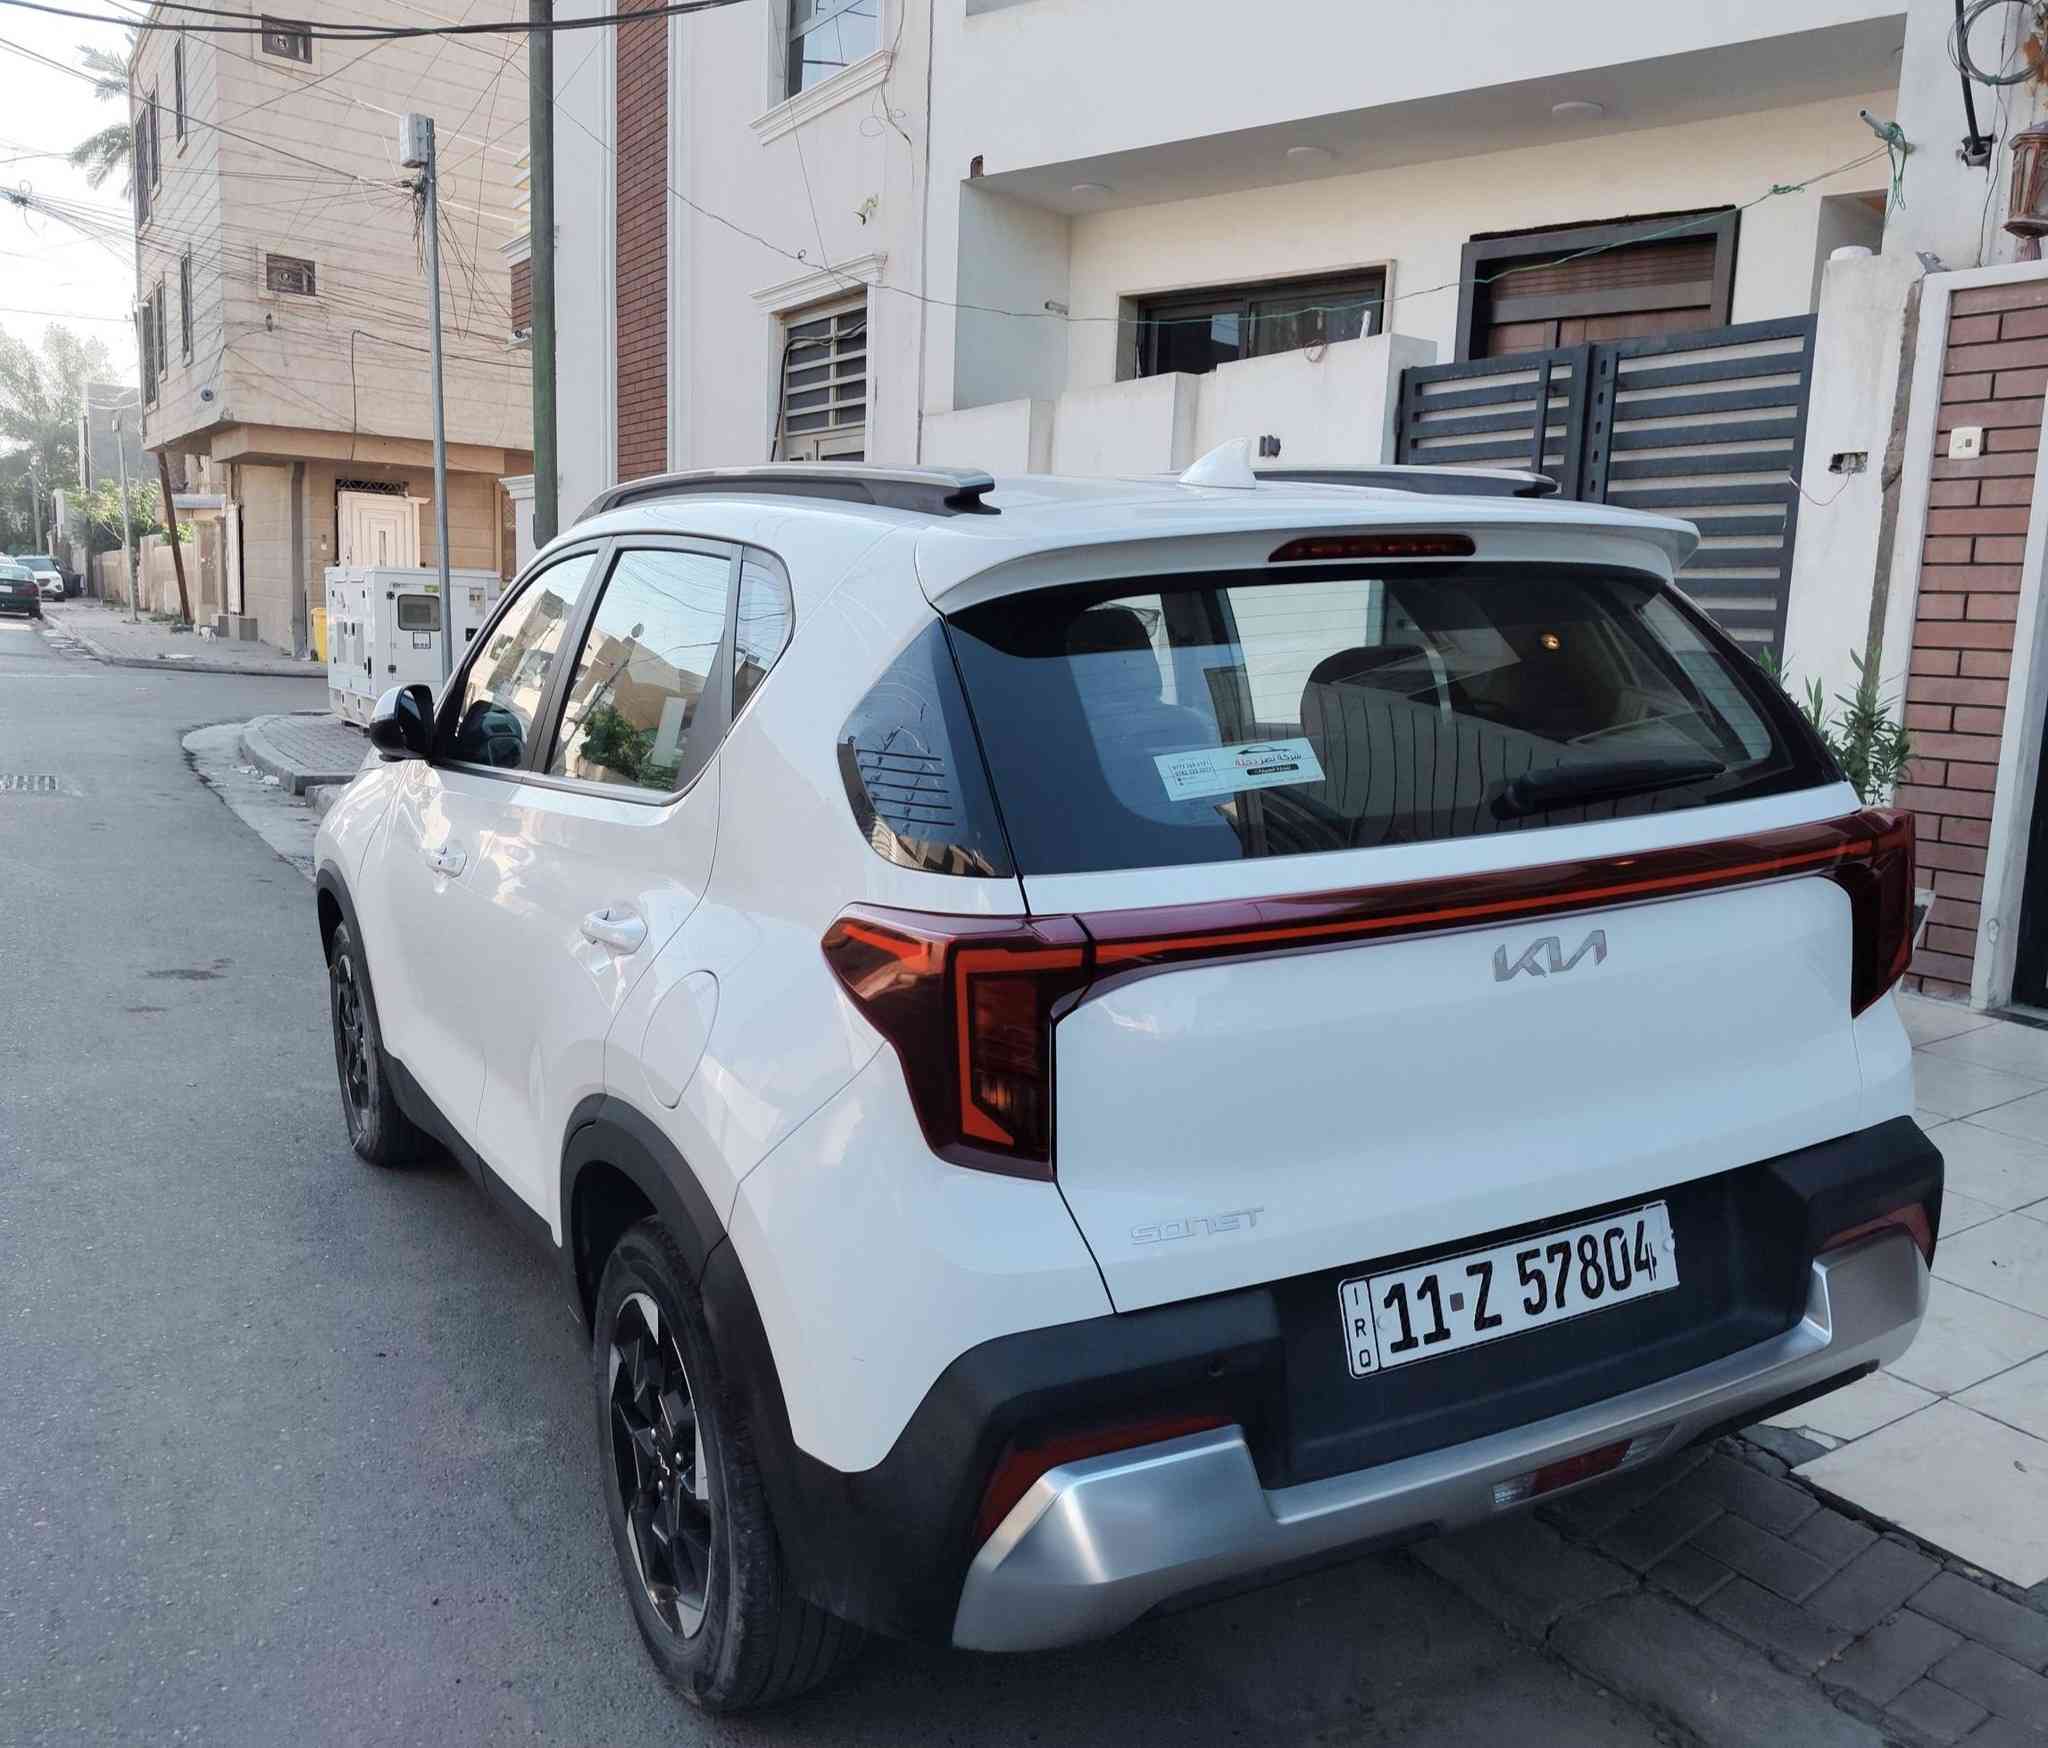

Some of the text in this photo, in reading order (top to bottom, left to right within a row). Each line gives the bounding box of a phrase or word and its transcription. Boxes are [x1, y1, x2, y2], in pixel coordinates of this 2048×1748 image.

[1494, 929, 1608, 982] KIA
[1130, 1207, 1265, 1246] SONET
[1515, 1220, 1658, 1316] 57804
[1351, 1286, 1372, 1369] IRQ
